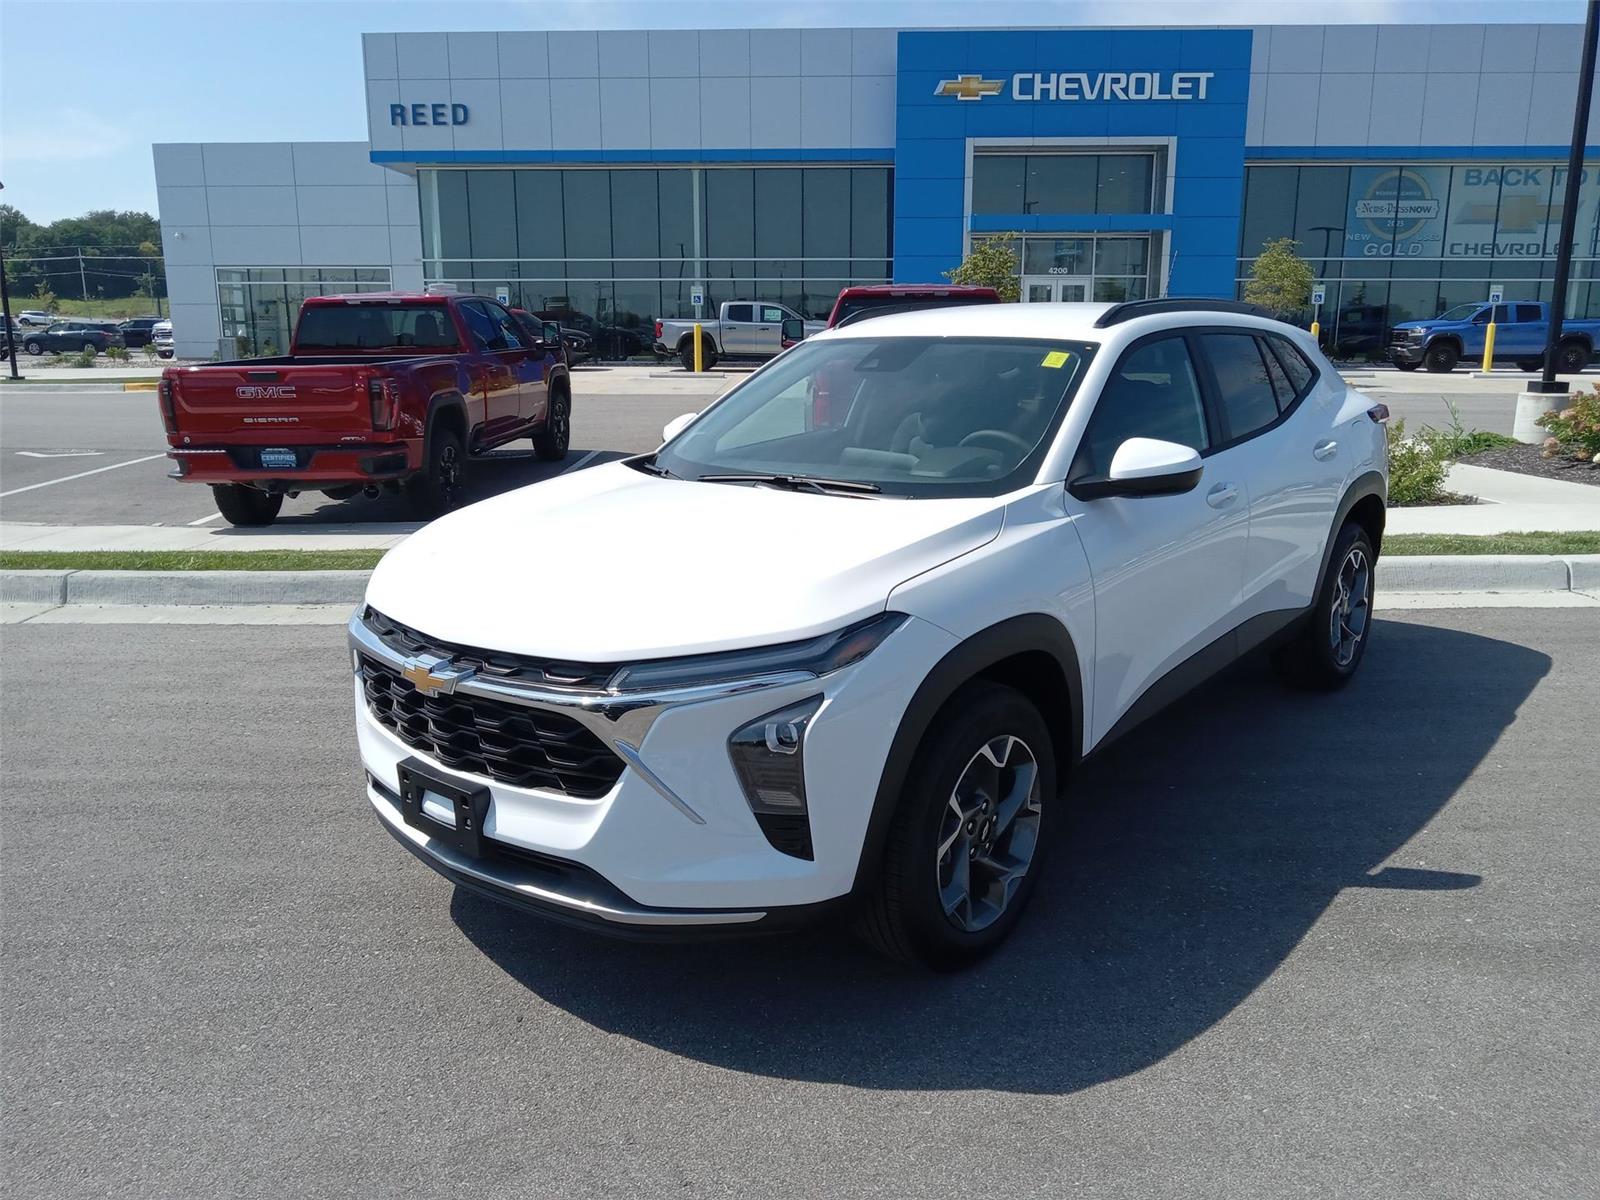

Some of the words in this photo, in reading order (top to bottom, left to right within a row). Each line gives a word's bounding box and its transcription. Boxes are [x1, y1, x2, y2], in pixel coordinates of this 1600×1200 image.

[1012, 72, 1214, 100] CHEVROLET
[389, 103, 469, 126] REED
[1464, 168, 1542, 187] BACK
[1345, 233, 1371, 241] NEW
[1363, 242, 1423, 256] GOLD
[236, 386, 297, 399] GMC
